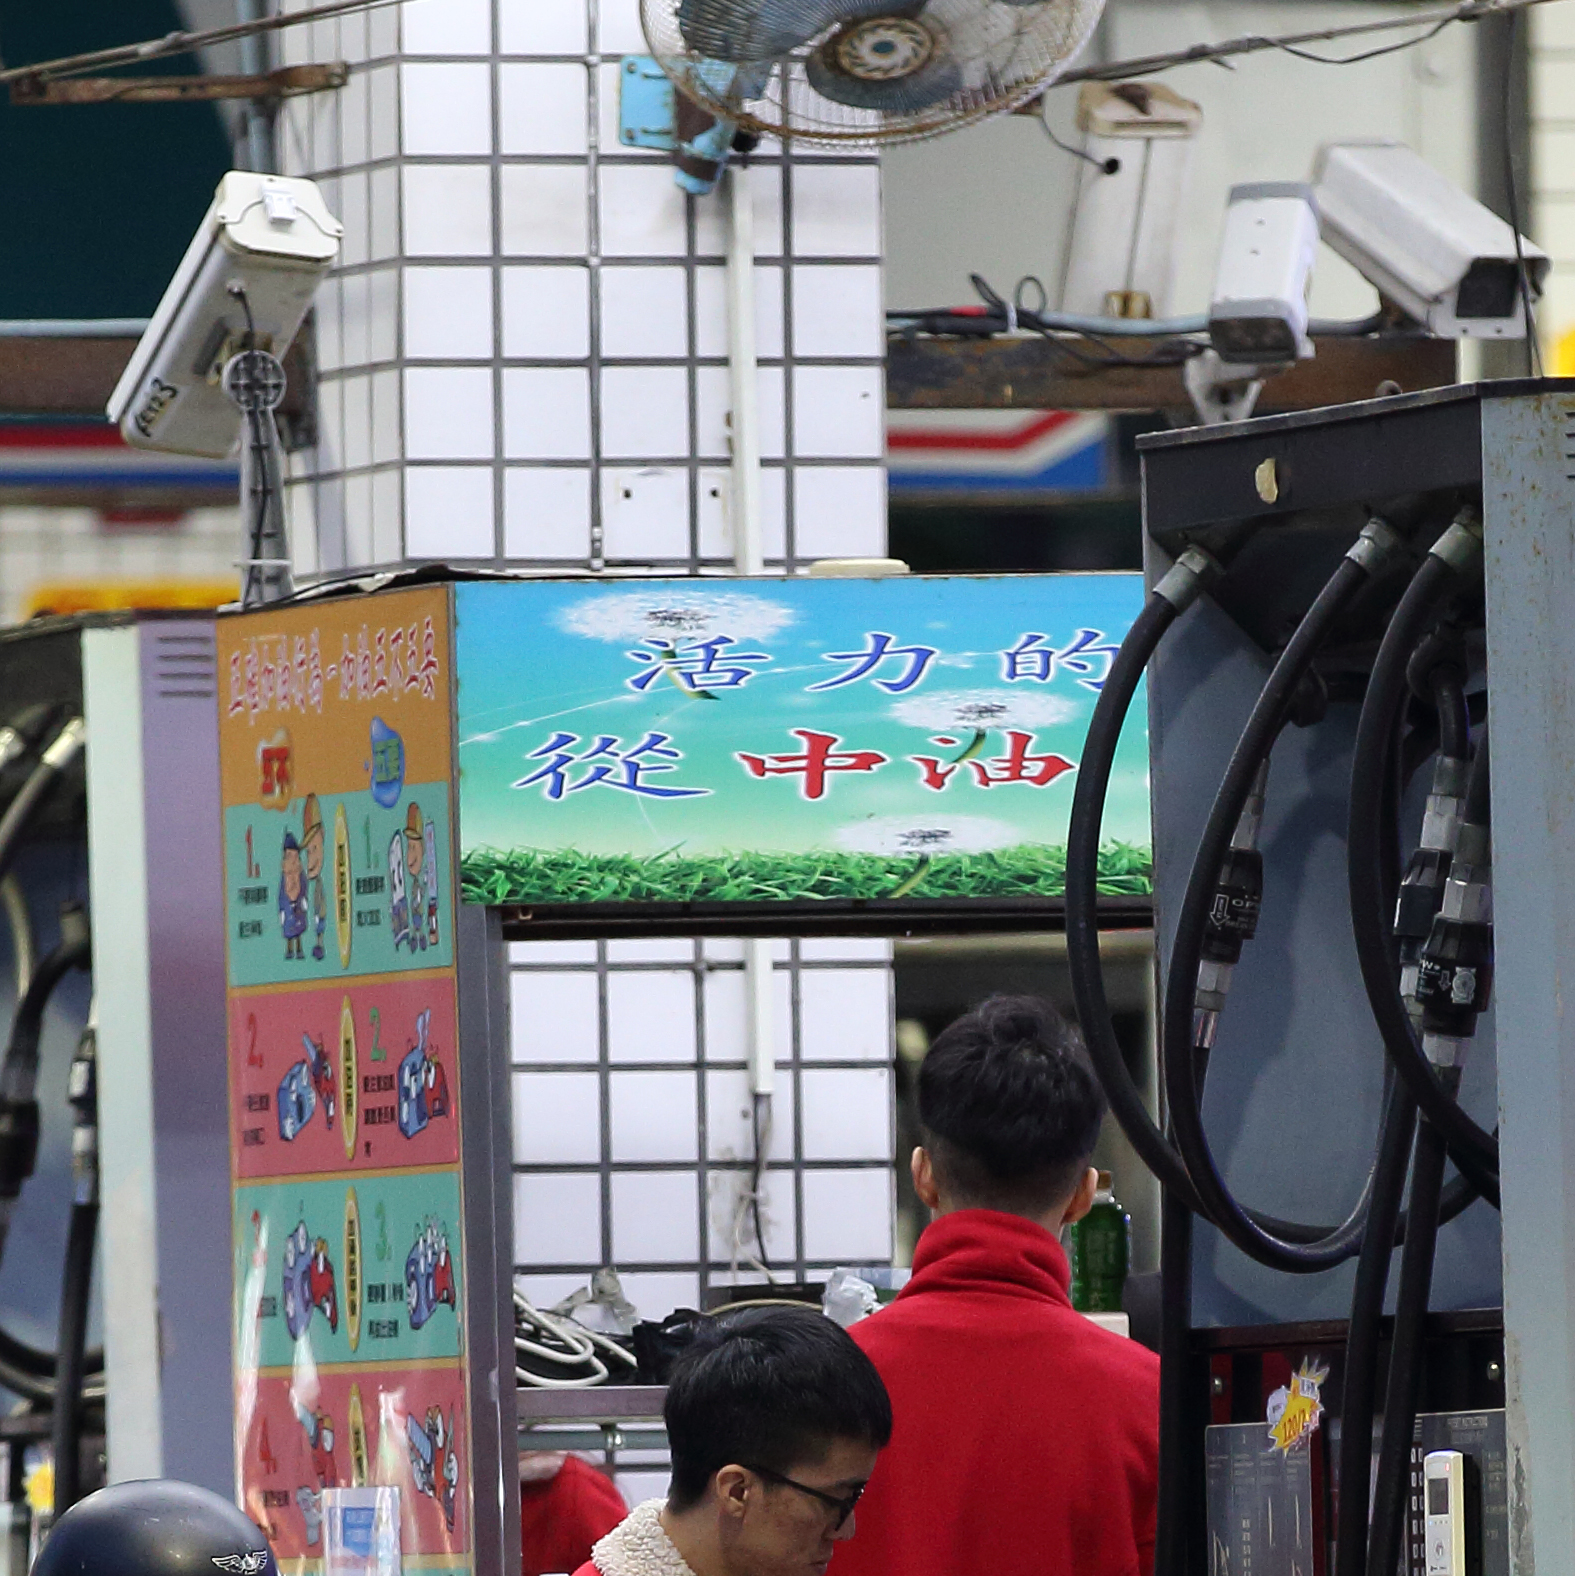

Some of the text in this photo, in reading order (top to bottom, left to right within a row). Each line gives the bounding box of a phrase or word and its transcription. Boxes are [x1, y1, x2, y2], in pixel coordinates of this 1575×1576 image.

[627, 630, 1122, 694] 活力的
[514, 729, 1078, 800] 從中油
